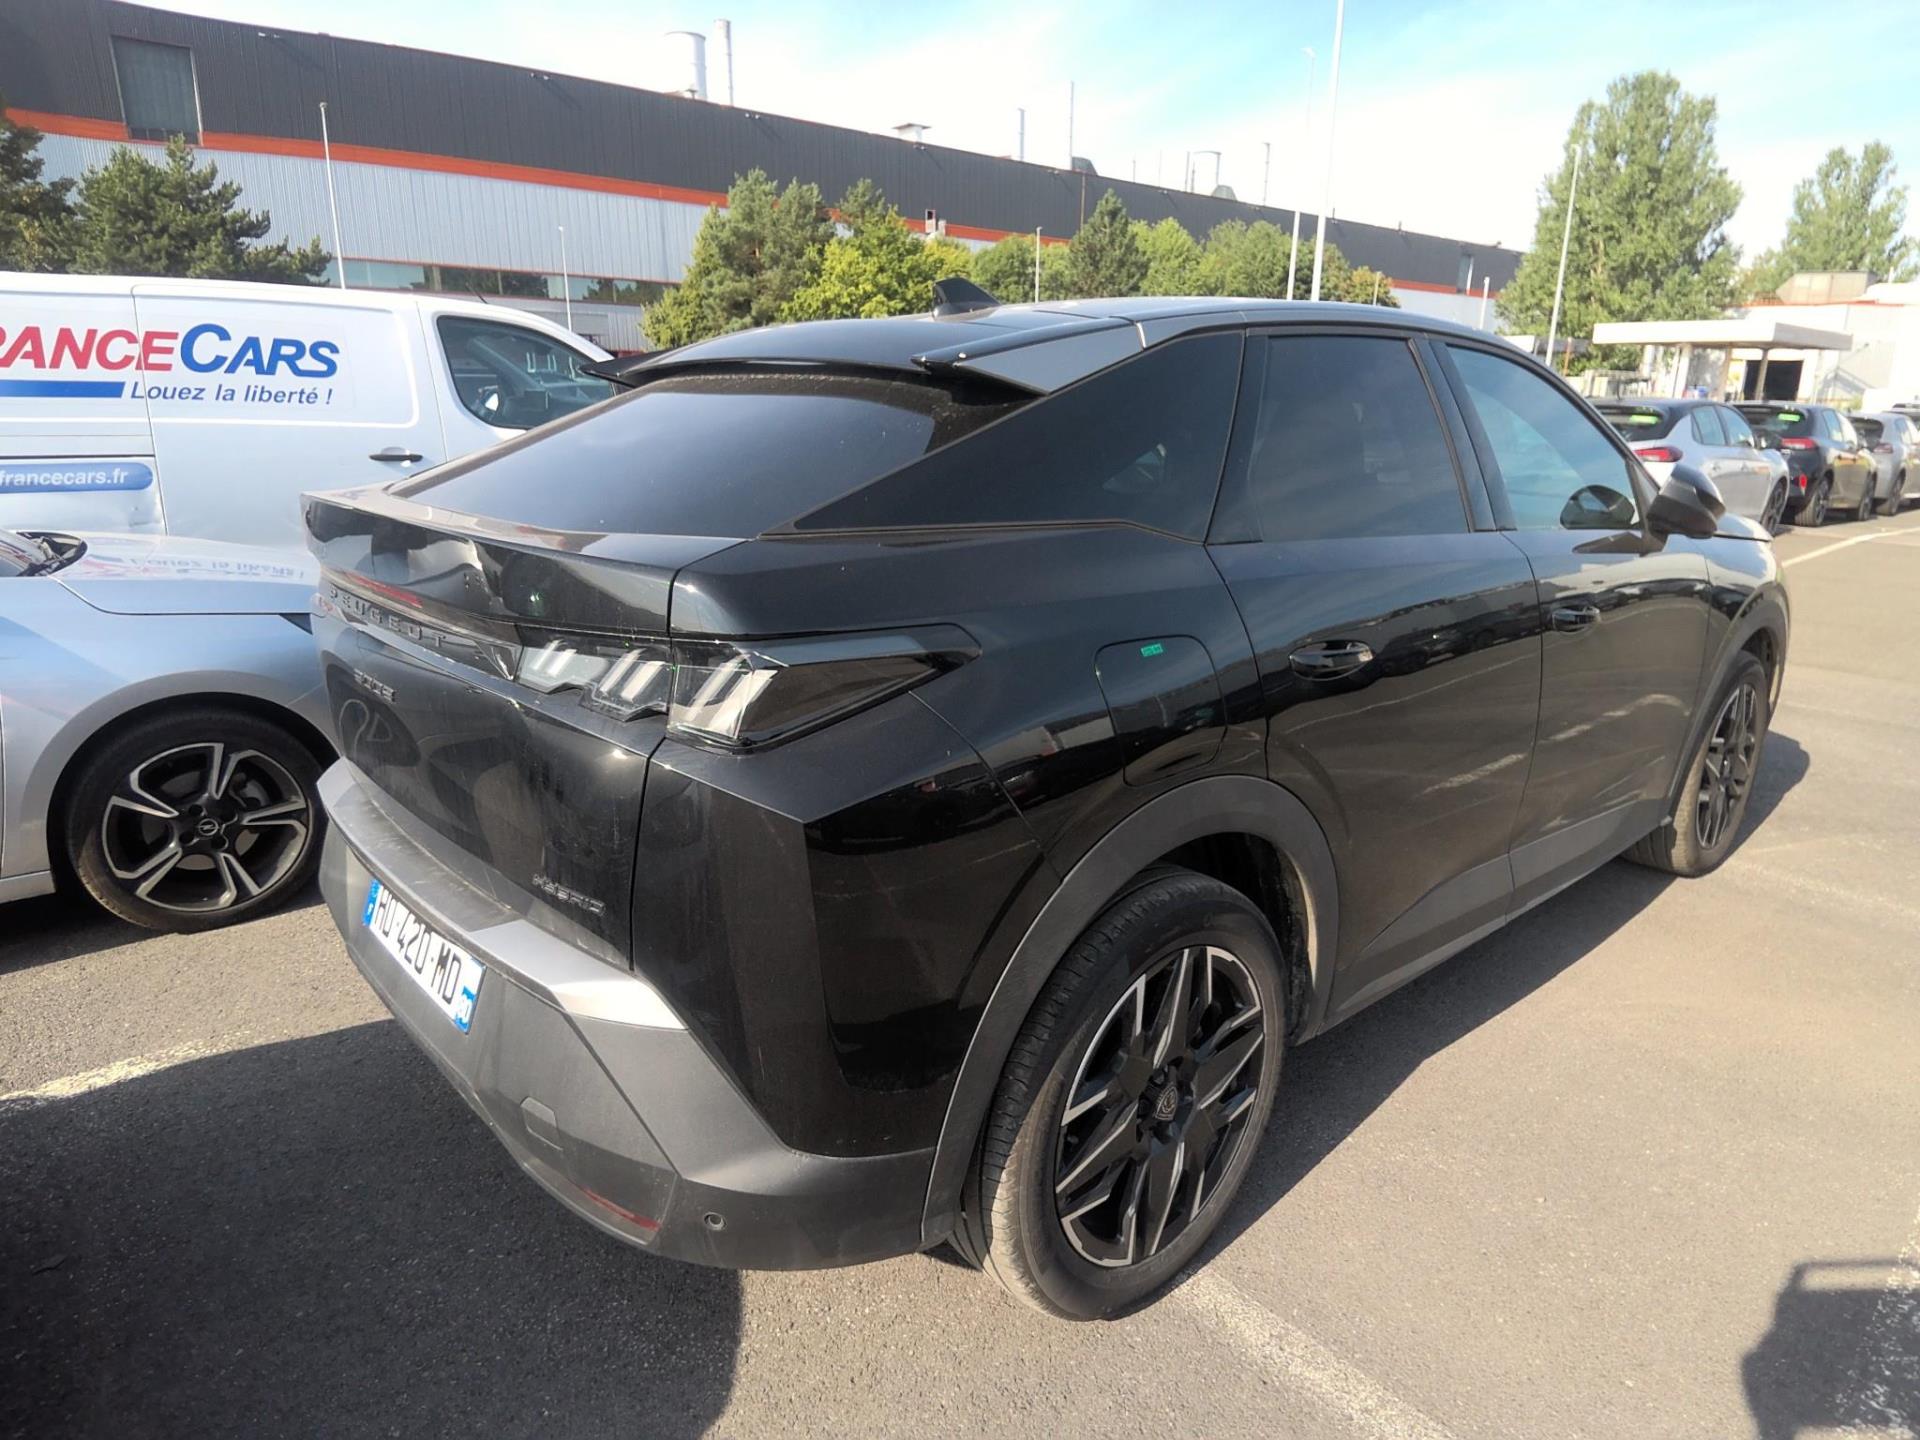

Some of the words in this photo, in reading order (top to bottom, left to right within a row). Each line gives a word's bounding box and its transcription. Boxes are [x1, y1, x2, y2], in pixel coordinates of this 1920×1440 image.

[131, 381, 205, 400] Louez
[214, 384, 236, 403] la
[244, 385, 318, 405] liberté
